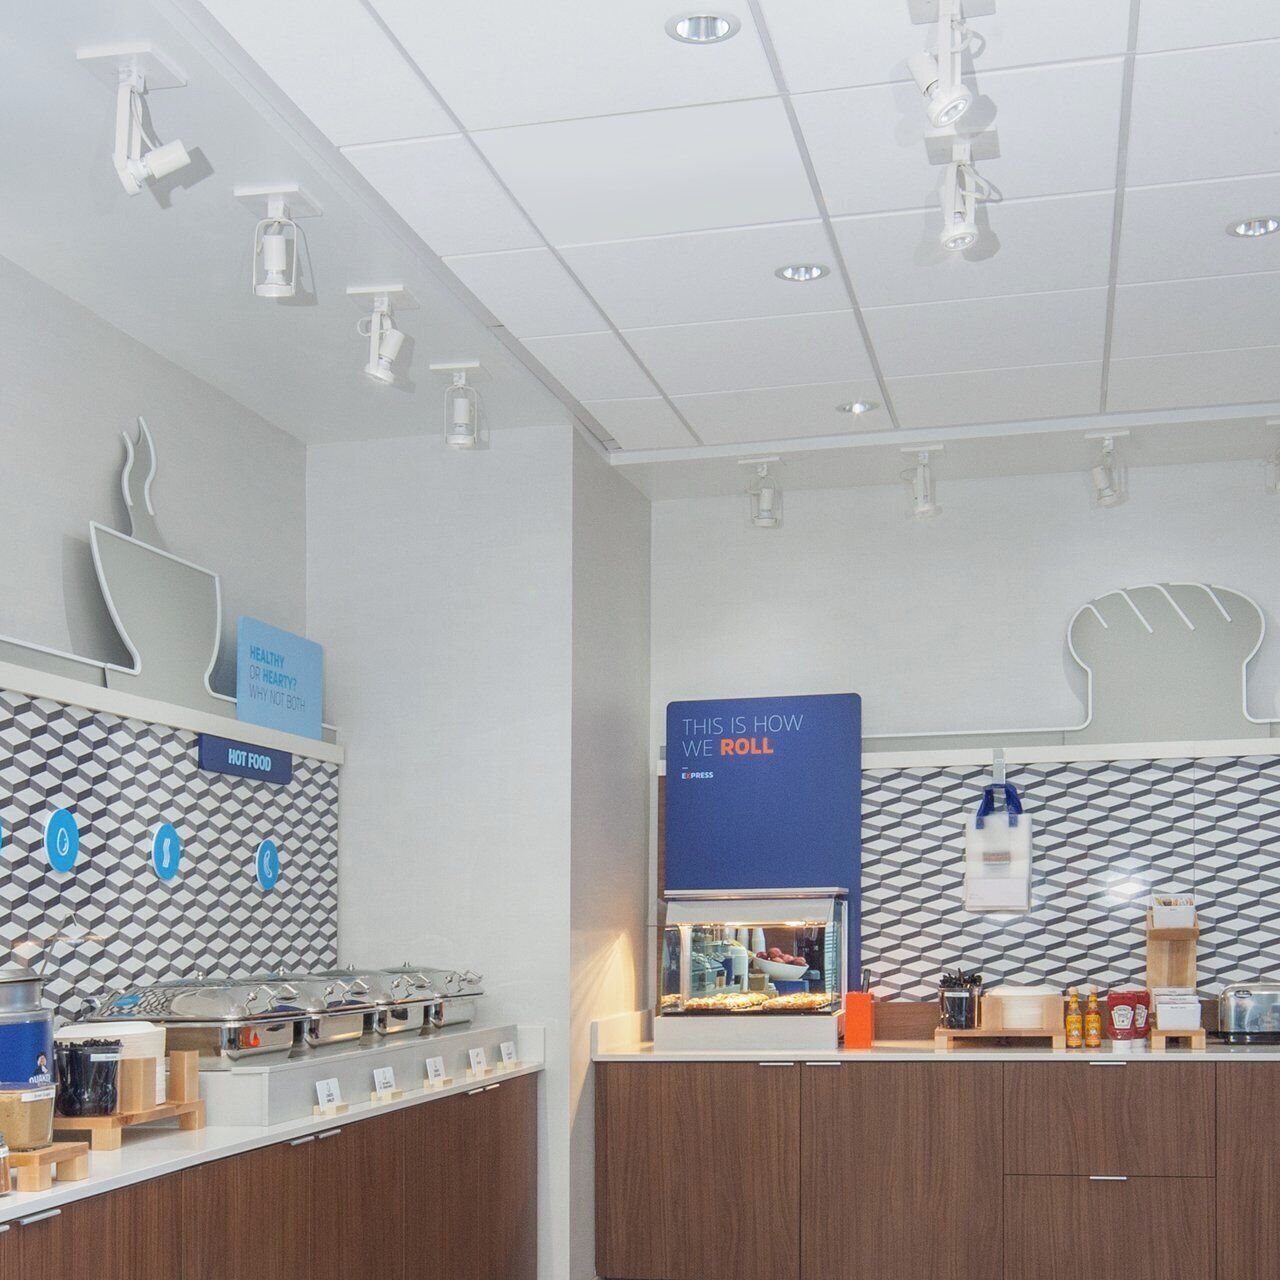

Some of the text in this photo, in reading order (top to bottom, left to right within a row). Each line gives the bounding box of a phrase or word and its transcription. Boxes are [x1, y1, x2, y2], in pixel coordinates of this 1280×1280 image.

[250, 645, 285, 668] HEALTHY
[249, 664, 297, 691] OR HEARTY?
[249, 682, 268, 702] WHY
[270, 689, 285, 707] NOT
[682, 714, 803, 735] THIS IS HOW
[682, 737, 774, 757] WE ROLL
[228, 748, 271, 772] HOT FOOD
[681, 771, 714, 780] EXPRESS
